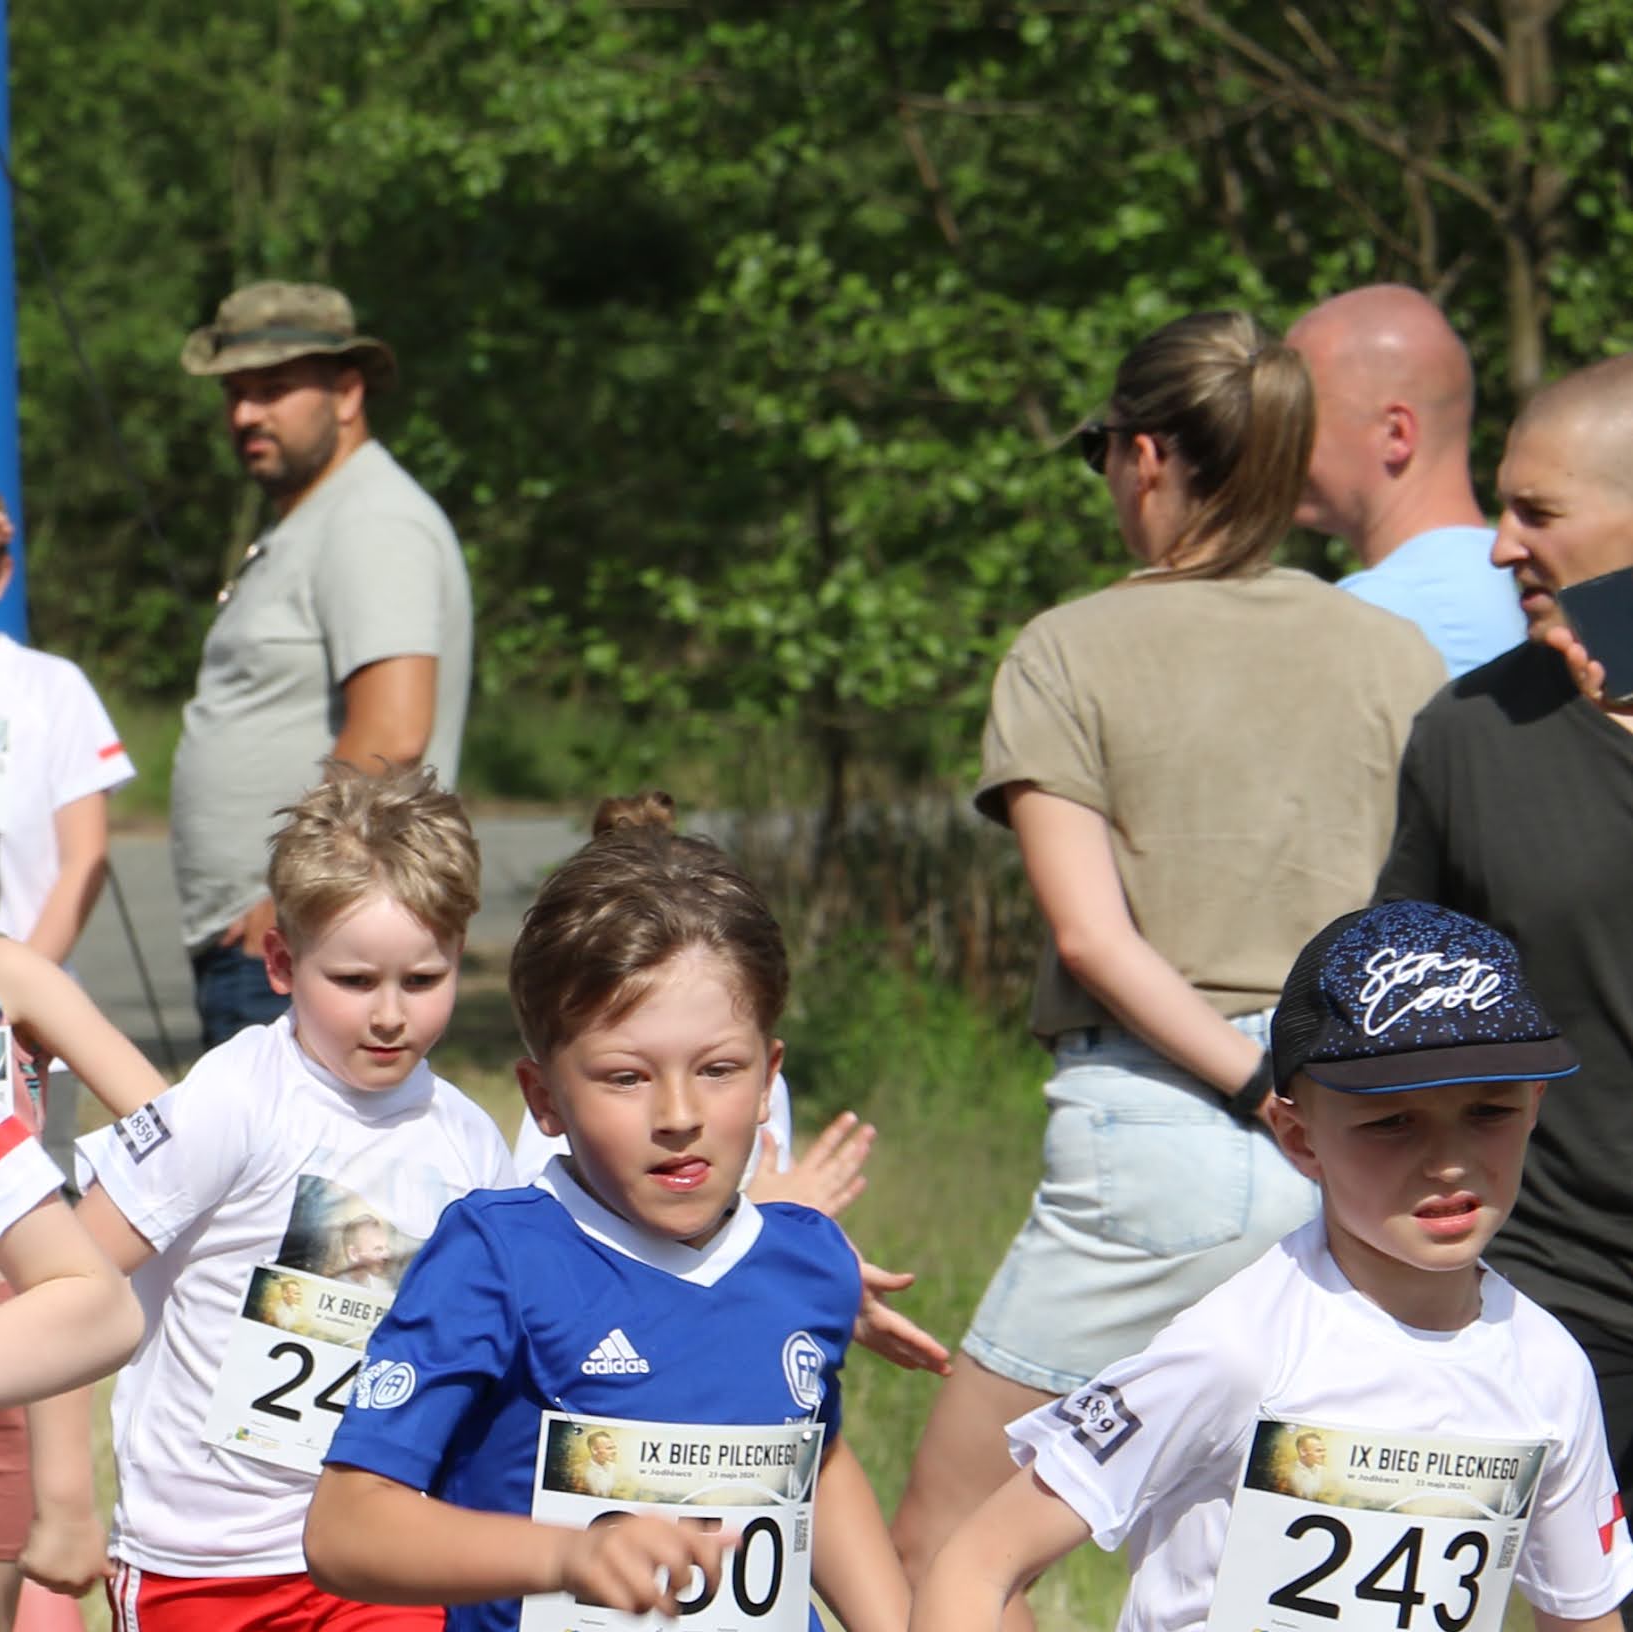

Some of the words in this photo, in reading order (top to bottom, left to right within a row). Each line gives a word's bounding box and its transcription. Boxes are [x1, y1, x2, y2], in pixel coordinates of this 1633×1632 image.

[1359, 947, 1495, 1004] Stay
[1363, 972, 1504, 1037] Cool
[319, 1293, 336, 1312] IX
[340, 1297, 371, 1321] BIEG
[580, 1357, 650, 1374] adidas
[640, 1442, 661, 1463] IX
[670, 1443, 710, 1465] BIEG
[717, 1443, 797, 1467] PILECKIEGO
[1349, 1445, 1372, 1468] IX
[1378, 1448, 1419, 1473] BIEG
[1425, 1452, 1519, 1480] PILECKIEGO
